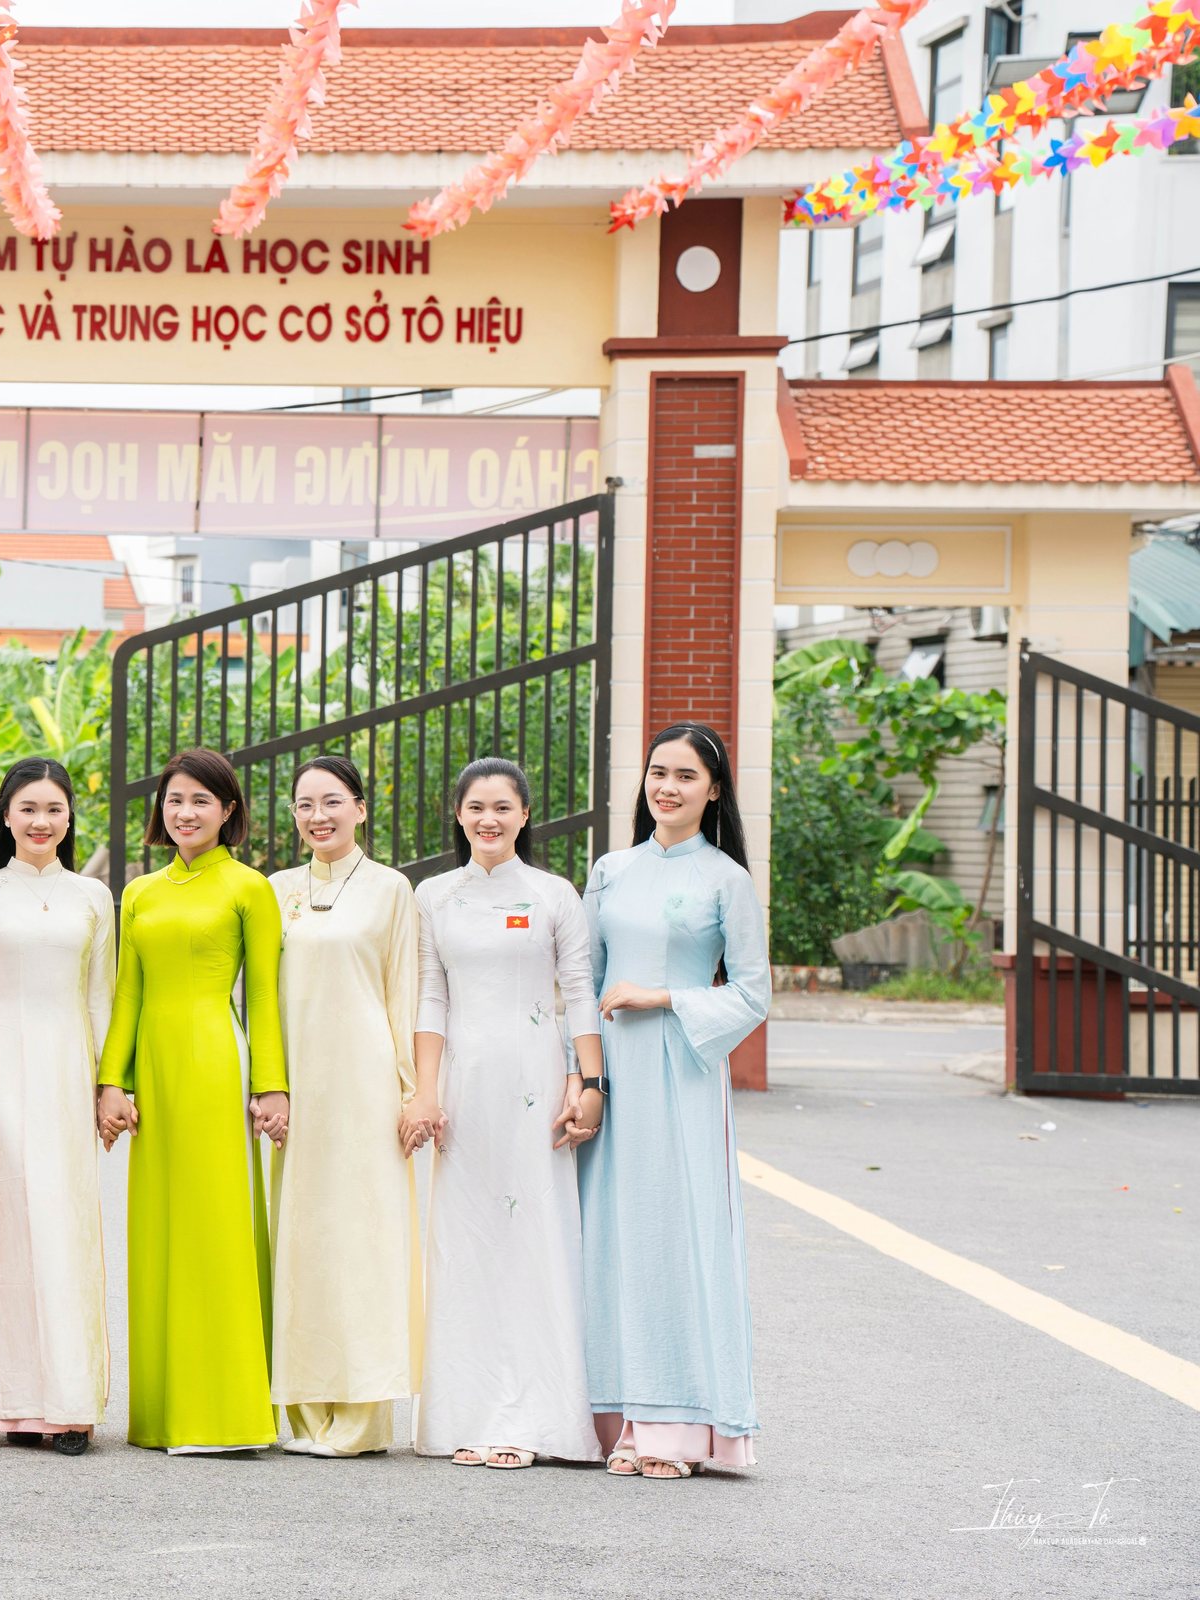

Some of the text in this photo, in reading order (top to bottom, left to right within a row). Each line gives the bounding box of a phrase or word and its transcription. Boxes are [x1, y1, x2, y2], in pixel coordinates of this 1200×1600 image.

[30, 231, 78, 283] TỰ
[88, 225, 174, 274] HÀO
[242, 238, 330, 285] HỌC
[341, 239, 432, 275] SINH
[18, 289, 61, 341] VÀ
[72, 304, 181, 342] TRUNG
[192, 304, 268, 351] HỌC
[278, 302, 333, 343] CƠ
[344, 289, 392, 343] SỞ
[401, 295, 445, 343] TÔ
[456, 296, 524, 353] HIỆU
